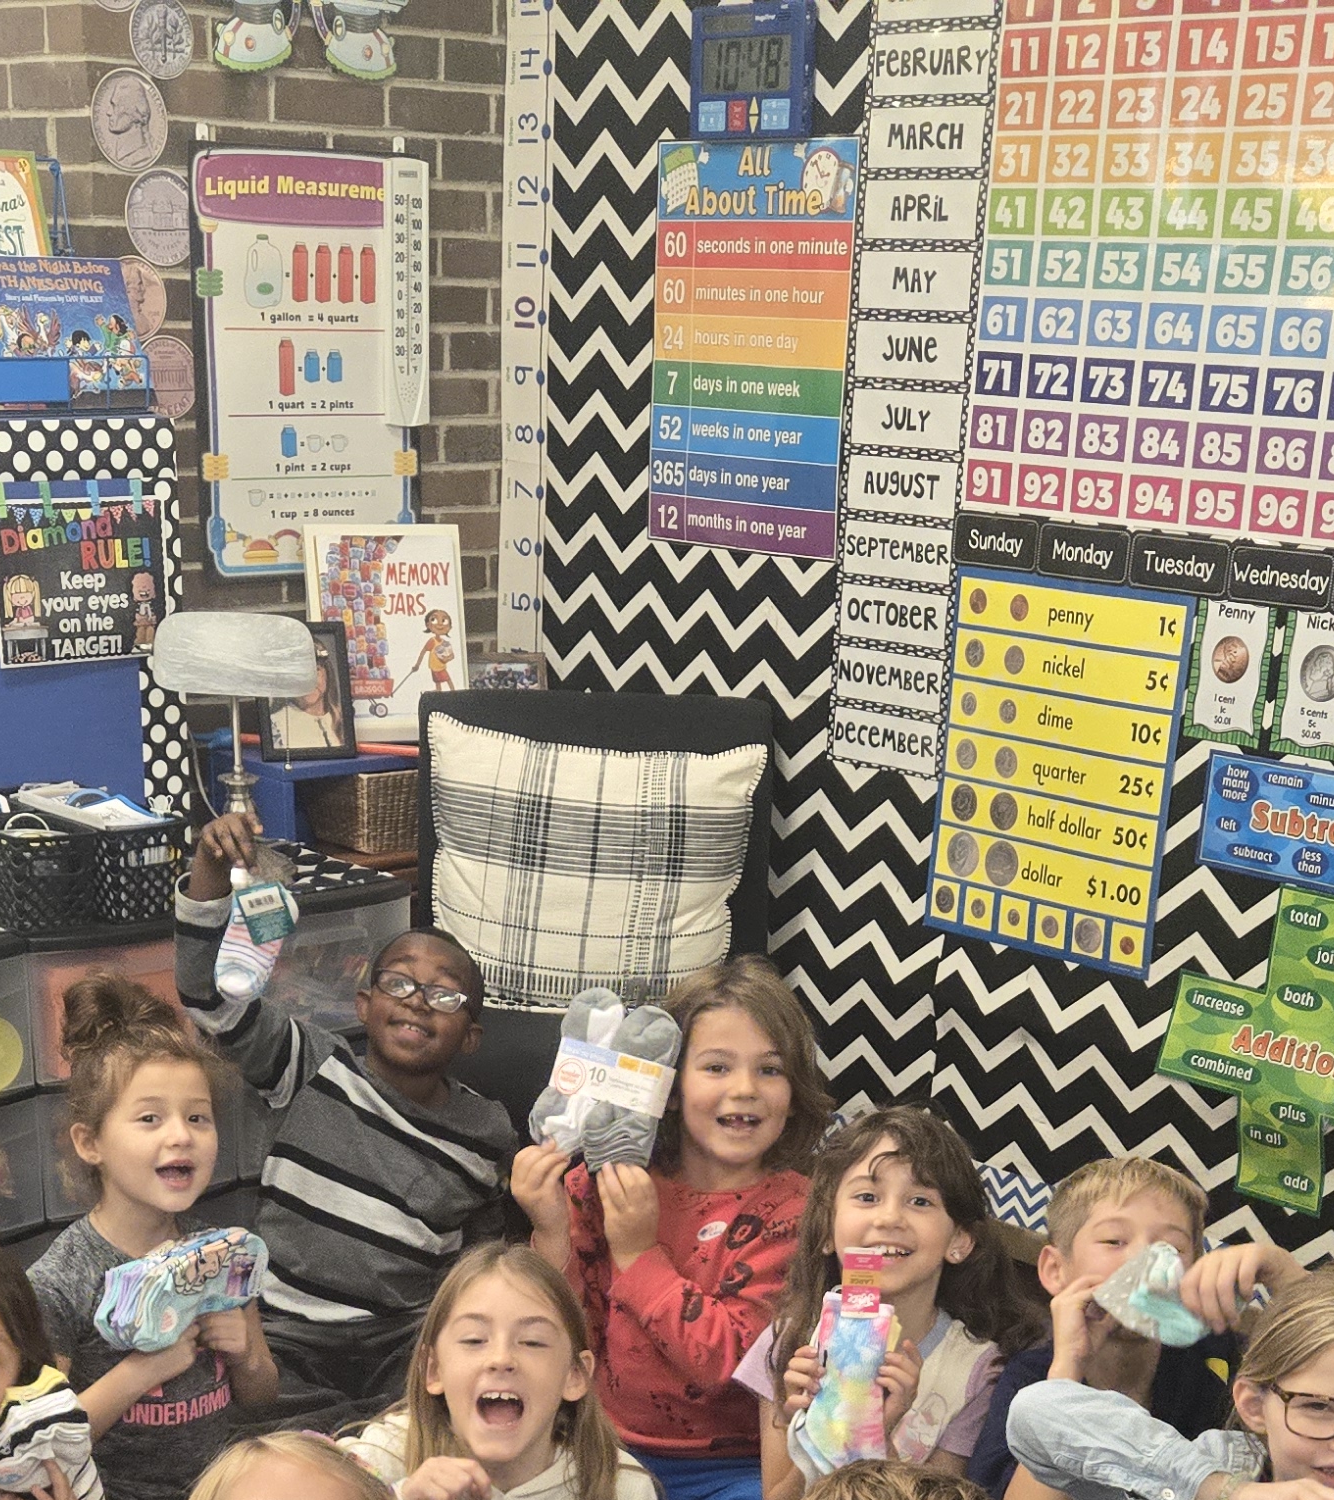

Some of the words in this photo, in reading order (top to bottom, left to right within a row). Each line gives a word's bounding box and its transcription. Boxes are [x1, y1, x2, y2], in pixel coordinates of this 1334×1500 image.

[887, 122, 964, 150] MARCH
[737, 145, 771, 178] All
[205, 175, 269, 200] Liquid
[277, 175, 384, 201] Measureme
[685, 184, 757, 217] About
[765, 182, 823, 217] Time
[665, 232, 686, 258] 60
[697, 238, 750, 255] seconds
[754, 238, 765, 254] in
[770, 242, 793, 256] one
[797, 238, 848, 256] minute
[18, 259, 37, 272] the
[39, 259, 71, 274] Night
[73, 261, 110, 276] Before
[892, 266, 937, 293] MAY
[269, 312, 301, 324] gallon
[328, 313, 359, 324] quarts
[882, 404, 931, 432] JULY
[972, 467, 1002, 498] 91
[1024, 471, 1059, 505] 92
[1077, 476, 1113, 510] 93
[1134, 481, 1173, 516] 94
[1194, 486, 1236, 523] 95
[1258, 491, 1299, 529] 96
[0, 515, 113, 555] Diamond
[968, 528, 1024, 559] Sunday
[80, 537, 151, 570] RULE!
[1052, 538, 1113, 571] Monday
[1143, 549, 1215, 584] Tuesday
[60, 571, 106, 591] Keep
[385, 562, 450, 586] MEMORY
[1231, 561, 1331, 597] Wednesday
[42, 597, 86, 615] your
[88, 594, 129, 613] eyes
[384, 593, 426, 616] JARS
[58, 618, 84, 633] on
[87, 614, 114, 632] the
[1047, 606, 1094, 632] penny
[1158, 616, 1177, 638] 1¢
[52, 635, 123, 659] TARGET!
[1037, 705, 1073, 731] dime
[1130, 722, 1162, 745] 10¢
[1268, 772, 1305, 789] remain
[1026, 805, 1056, 830] half
[1058, 815, 1102, 840] dollar
[1111, 826, 1148, 850] 50¢
[1220, 816, 1237, 833] left
[1021, 861, 1063, 888] dollar
[1086, 874, 1141, 907] $1.00
[1289, 907, 1321, 929] total
[1192, 990, 1245, 1017] increase
[1283, 986, 1315, 1008] both
[1190, 1053, 1254, 1082] combined
[1278, 1103, 1307, 1123] plus
[1283, 1173, 1308, 1192] add
[122, 1401, 188, 1426] UNDER
[188, 1384, 231, 1421] ARMO
